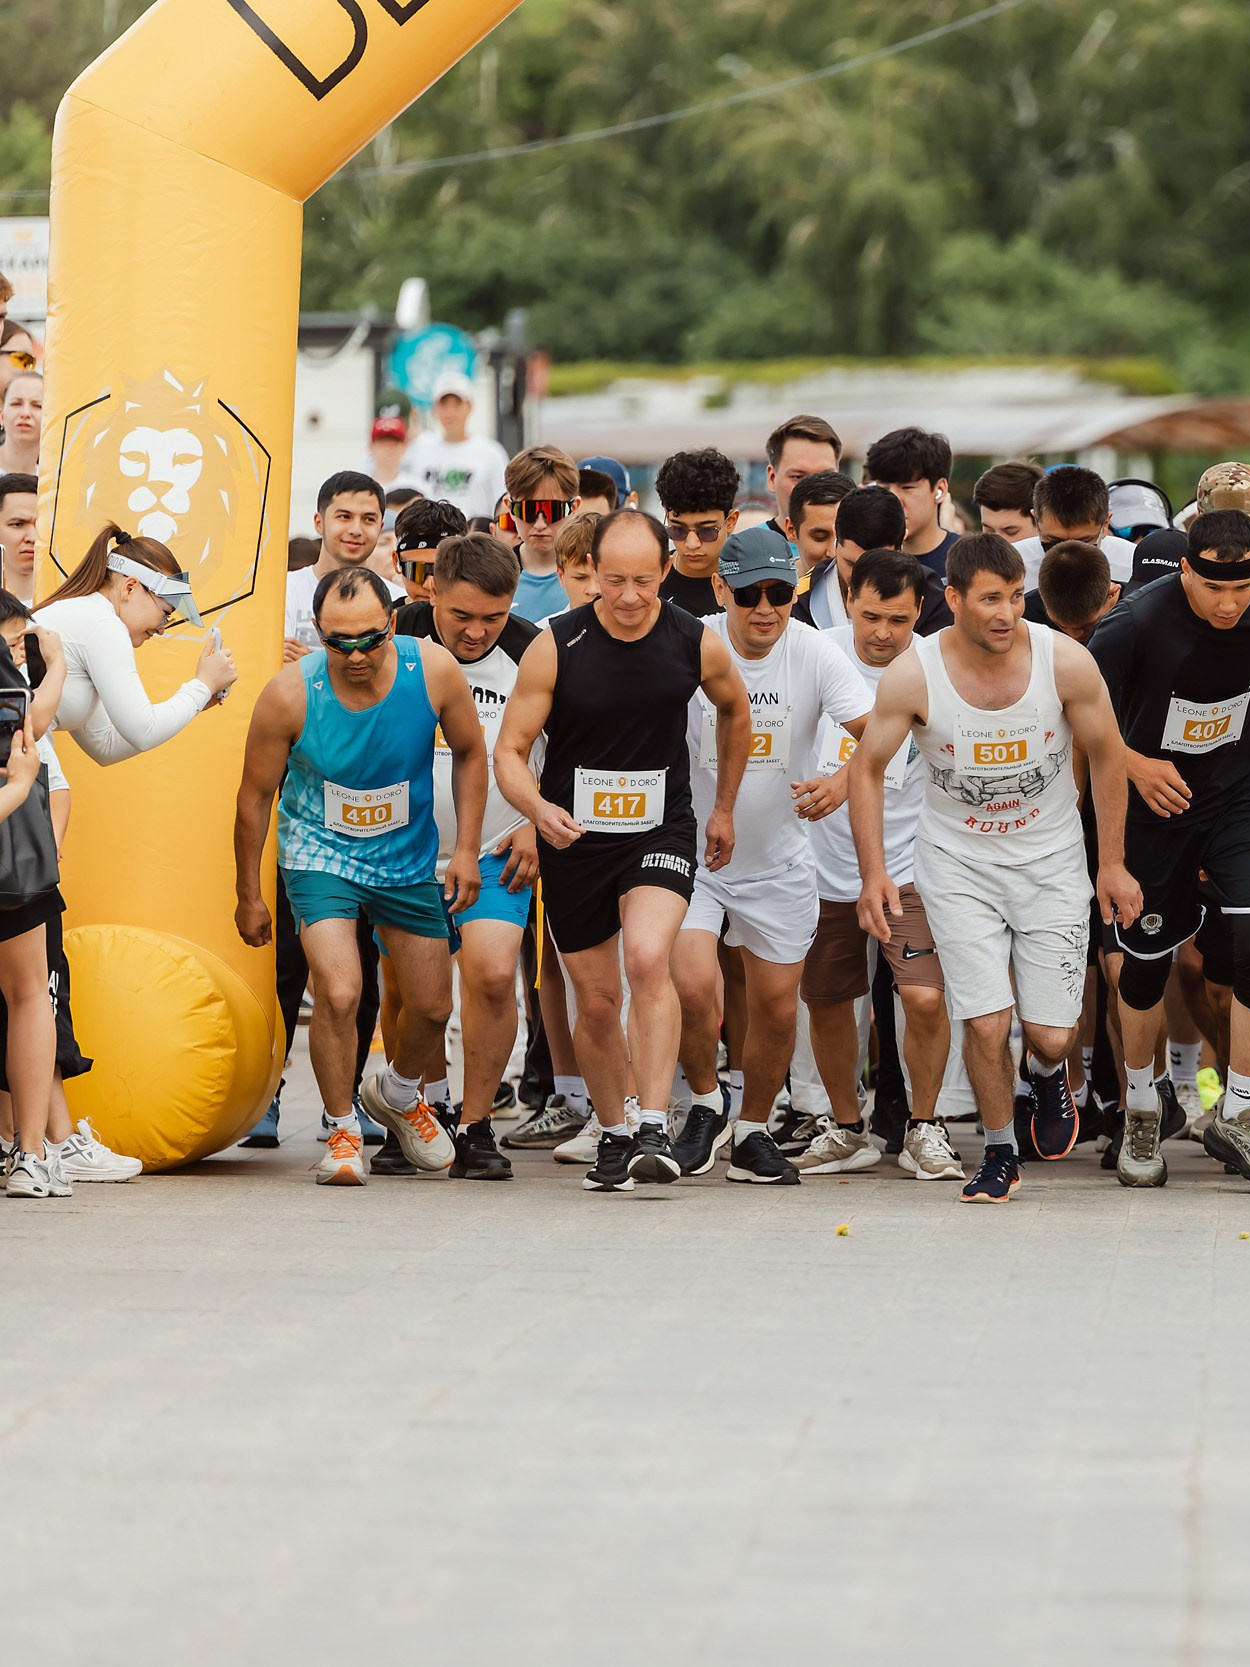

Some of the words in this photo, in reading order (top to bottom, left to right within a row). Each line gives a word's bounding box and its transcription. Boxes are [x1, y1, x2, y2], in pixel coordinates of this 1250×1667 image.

[1176, 705, 1208, 717] LEONE
[757, 720, 784, 728] D'ORO
[1188, 718, 1228, 739] 407
[961, 730, 993, 738] LEONE
[1010, 725, 1037, 737] D'ORO
[979, 743, 1019, 762] 501
[964, 763, 1022, 771] БЛАГОТВОРИТЕЛЬНЫЙ
[582, 777, 614, 787] LEONE
[630, 778, 658, 787] D'ORO
[331, 788, 360, 802] LEONE
[597, 795, 641, 815] 417
[986, 798, 1020, 812] AGAIN
[346, 806, 387, 824] 410
[964, 808, 1040, 833] ROUND
[582, 819, 640, 827] БЛАГОТВОРИТЕЛЬНЫЙ
[641, 853, 691, 878] ULTIMATE
